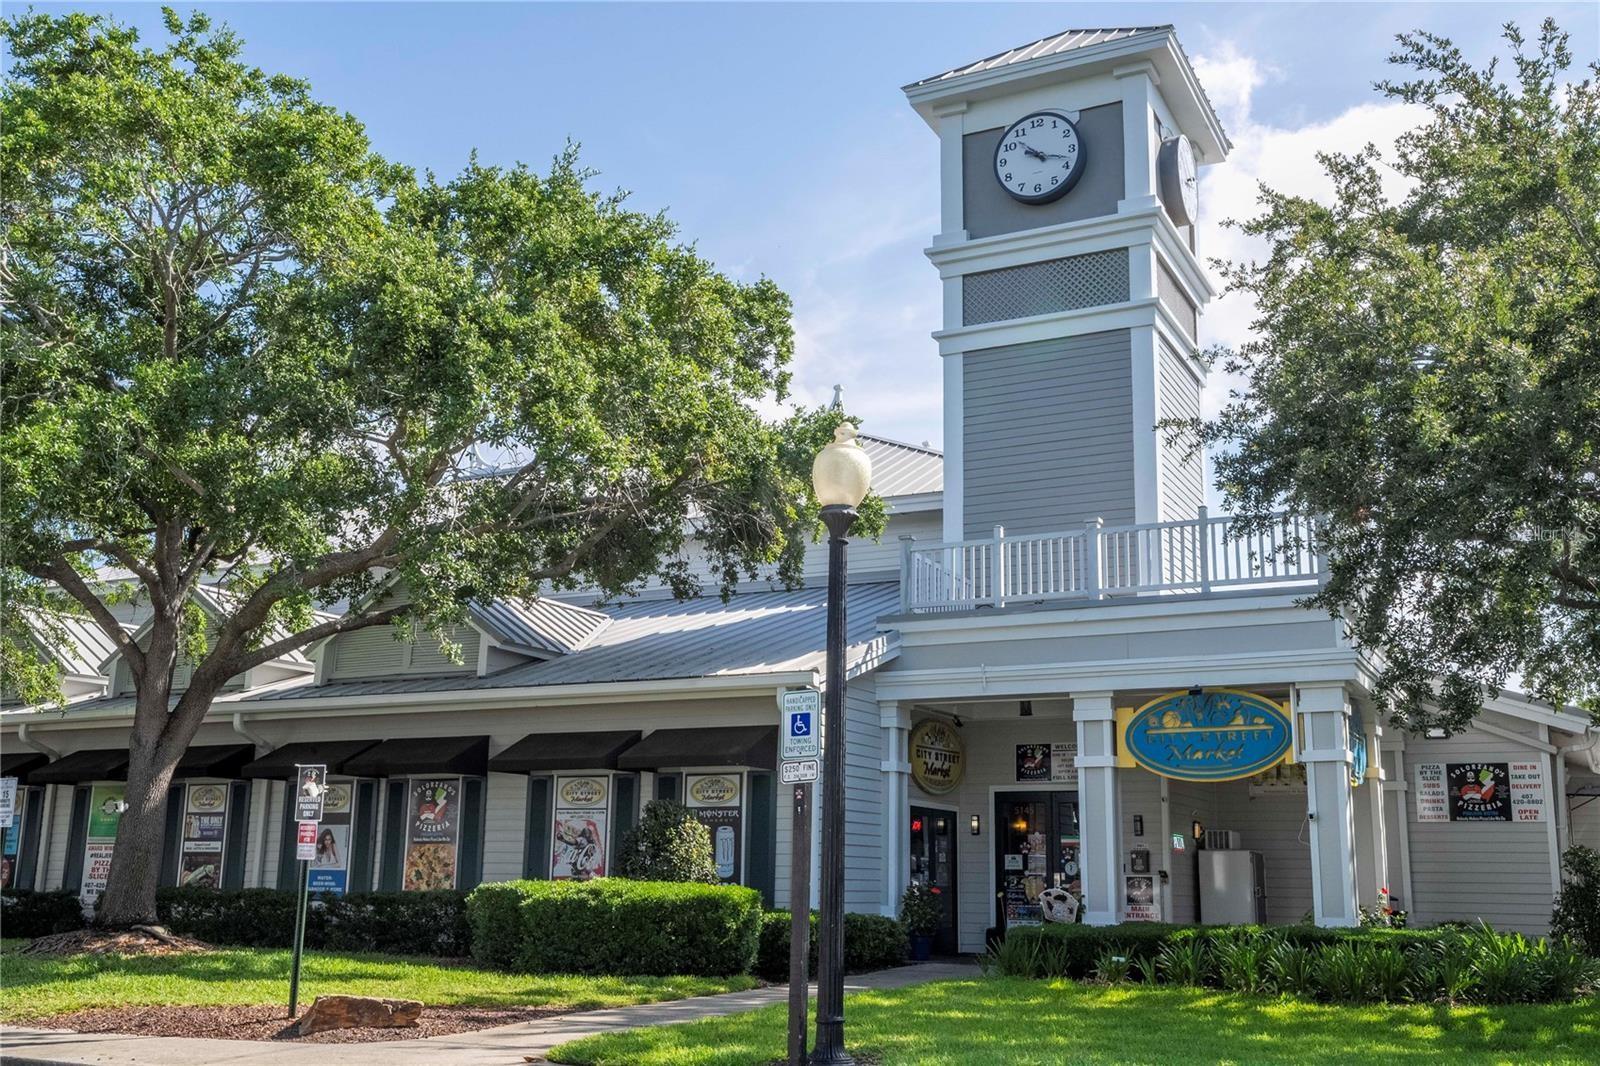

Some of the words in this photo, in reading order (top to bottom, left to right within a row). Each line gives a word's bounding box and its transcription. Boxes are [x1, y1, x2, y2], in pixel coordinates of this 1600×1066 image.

[1030, 118, 1044, 130] 12
[1052, 120, 1058, 128] 1
[1014, 128, 1026, 138] 11
[1063, 129, 1070, 138] 2
[1004, 142, 1017, 152] 10
[1068, 144, 1076, 153] 3
[1000, 158, 1008, 167] 9
[1062, 160, 1070, 170] 4
[1004, 173, 1013, 182] 8
[1051, 176, 1058, 185] 5
[1018, 182, 1026, 192] 7
[1034, 184, 1042, 192] 6
[790, 737, 812, 745] TOWING
[1146, 733, 1187, 744] CITY
[1202, 730, 1273, 743] STREET
[785, 745, 816, 754] ENFORCED
[1164, 742, 1245, 761] Market
[916, 748, 932, 760] CITY
[934, 752, 960, 765] STREET
[784, 765, 800, 774] $250
[802, 764, 815, 772] FINE
[923, 761, 950, 778] Market
[1450, 764, 1504, 778] SOLORZANO'S
[3, 790, 9, 798] 15
[1457, 800, 1502, 811] PIZZERIA
[699, 809, 739, 818] MONSTER
[416, 820, 450, 832] PIZZERIA
